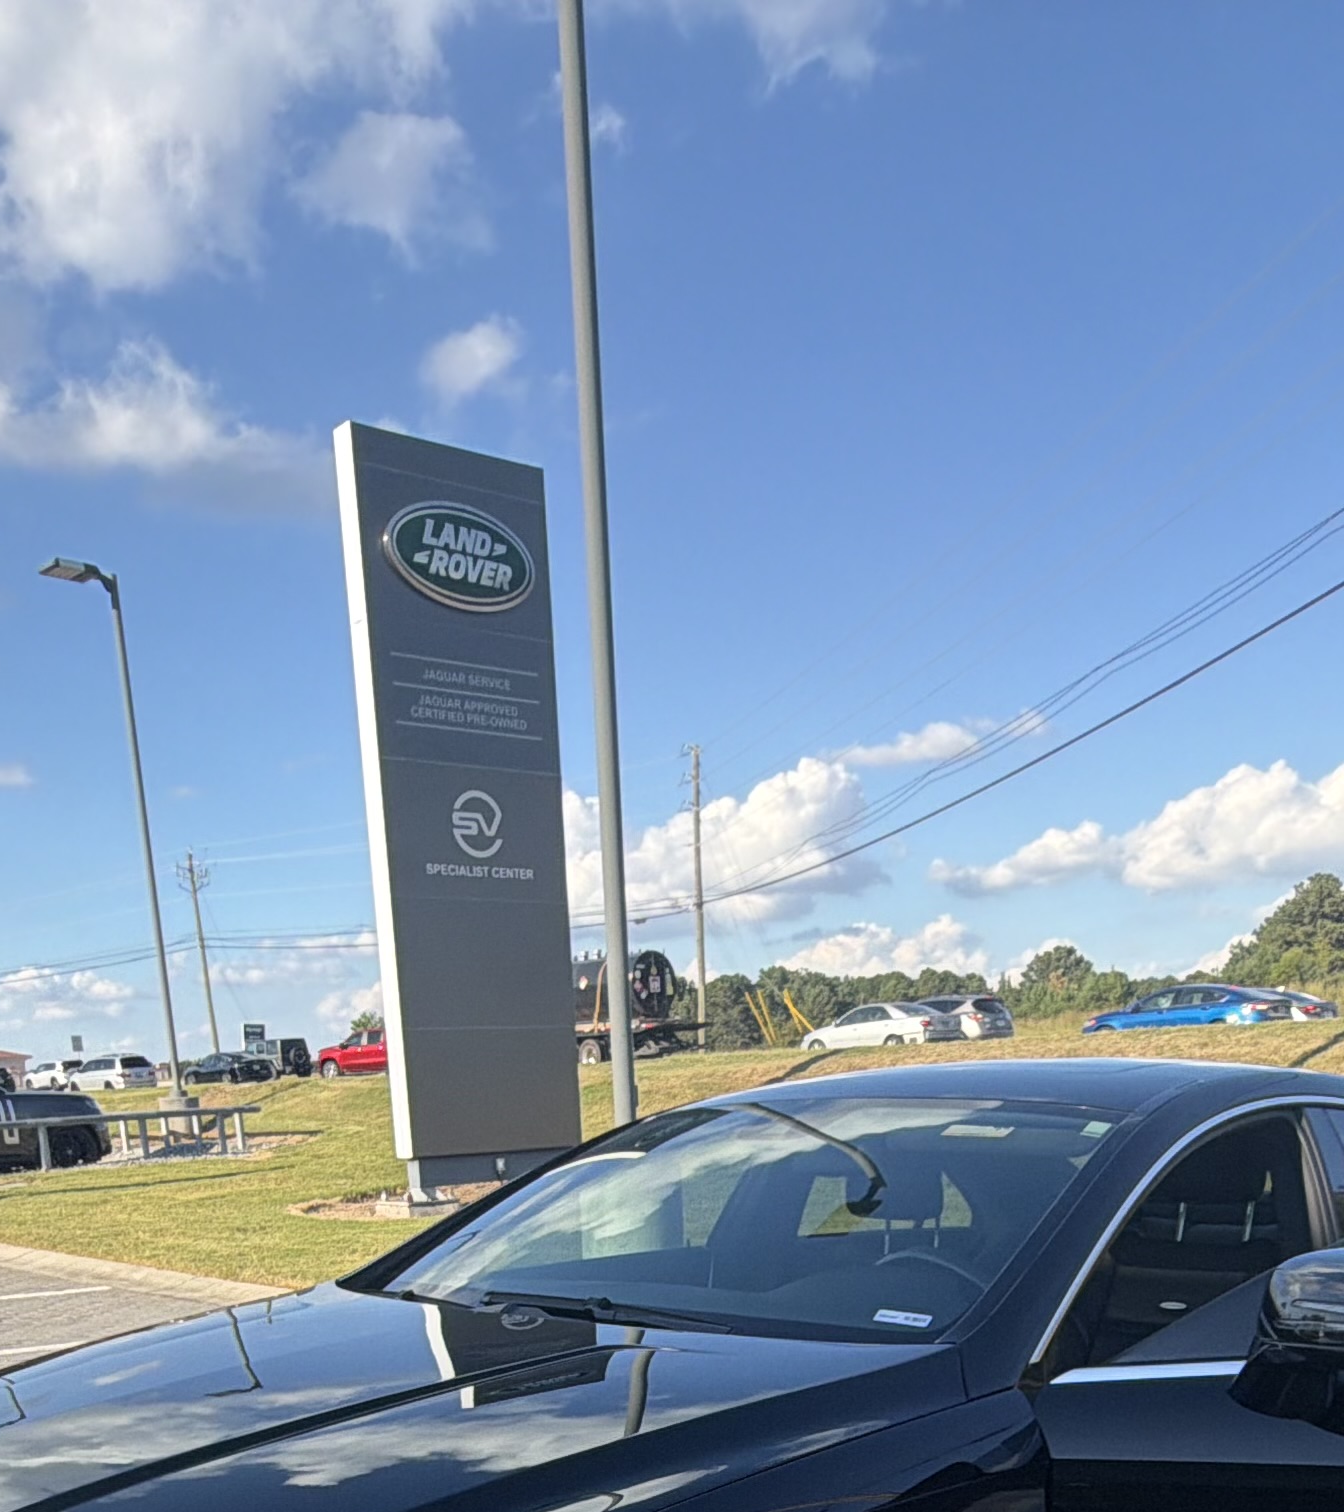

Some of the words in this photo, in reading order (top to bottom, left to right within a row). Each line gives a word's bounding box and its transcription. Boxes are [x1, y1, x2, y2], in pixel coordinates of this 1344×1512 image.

[422, 518, 492, 557] LAND
[428, 548, 513, 591] ROVER
[423, 669, 465, 683] JAGUAR
[468, 673, 511, 691] SERVICE
[410, 705, 464, 723] CERTIFIED
[467, 713, 527, 731] PRE-OWNED
[419, 695, 461, 710] JAGUAR
[464, 701, 518, 717] APPROVED
[426, 863, 489, 878] SPECIALIST
[491, 867, 534, 880] CENTER
